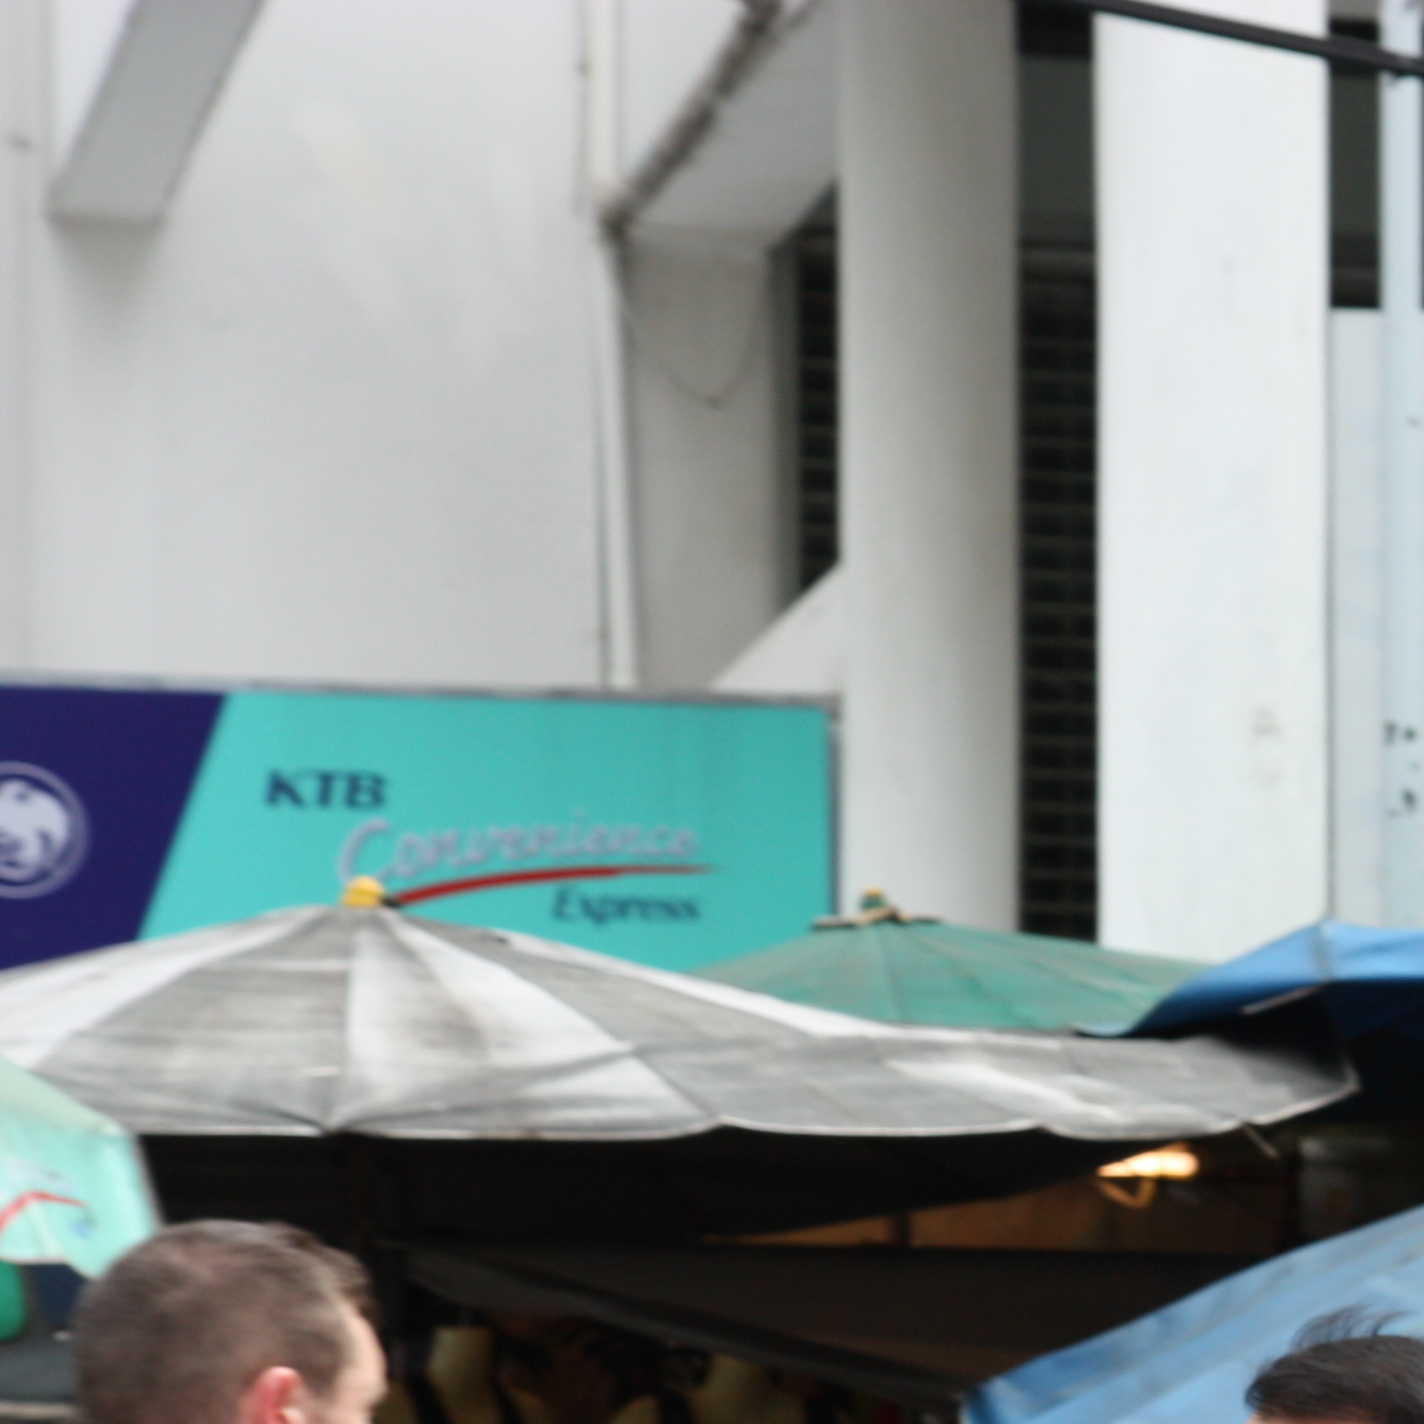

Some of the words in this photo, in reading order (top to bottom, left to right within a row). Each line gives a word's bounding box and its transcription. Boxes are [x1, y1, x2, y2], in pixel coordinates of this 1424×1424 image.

[264, 770, 387, 809] KTB
[337, 814, 700, 886] Convenience
[551, 884, 701, 926] Express
